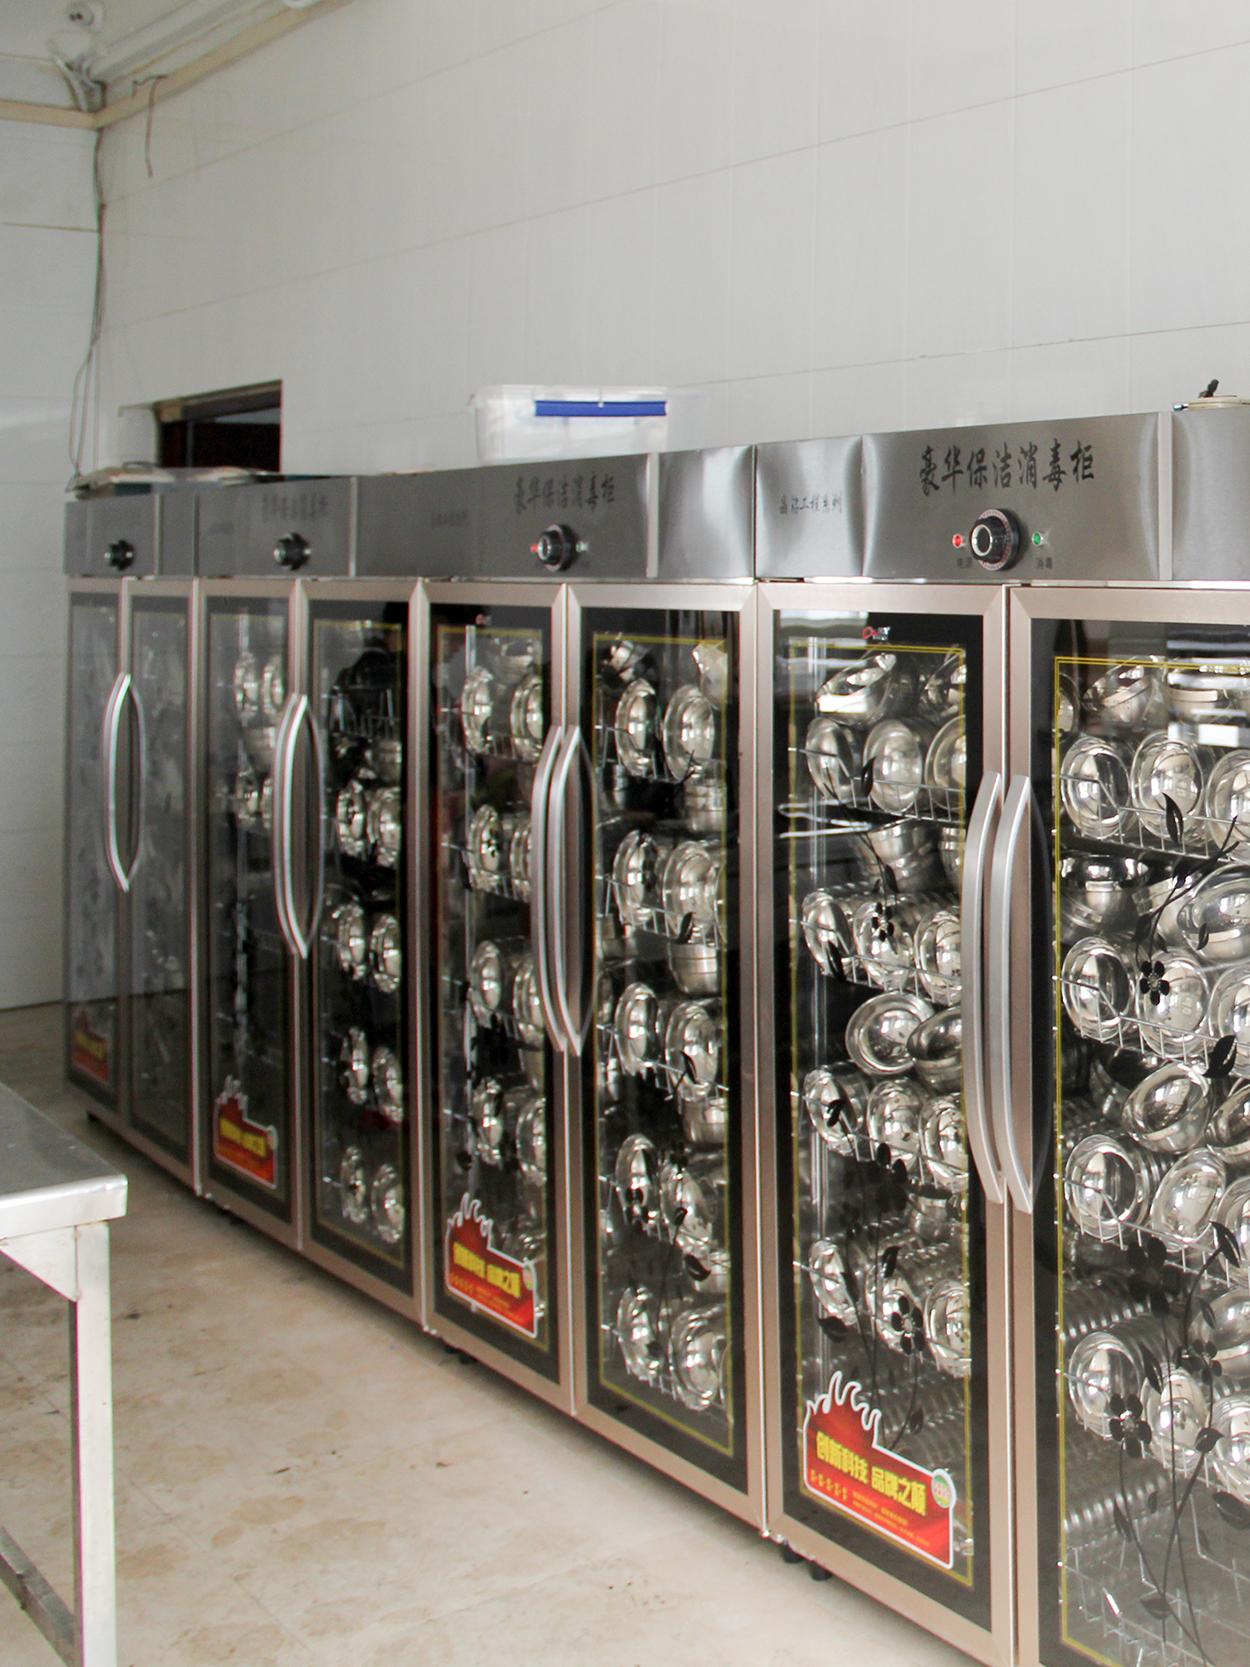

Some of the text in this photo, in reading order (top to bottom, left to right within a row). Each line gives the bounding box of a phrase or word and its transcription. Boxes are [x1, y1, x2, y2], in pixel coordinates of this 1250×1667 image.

[919, 438, 1095, 497] 豪华保洁消毒柜
